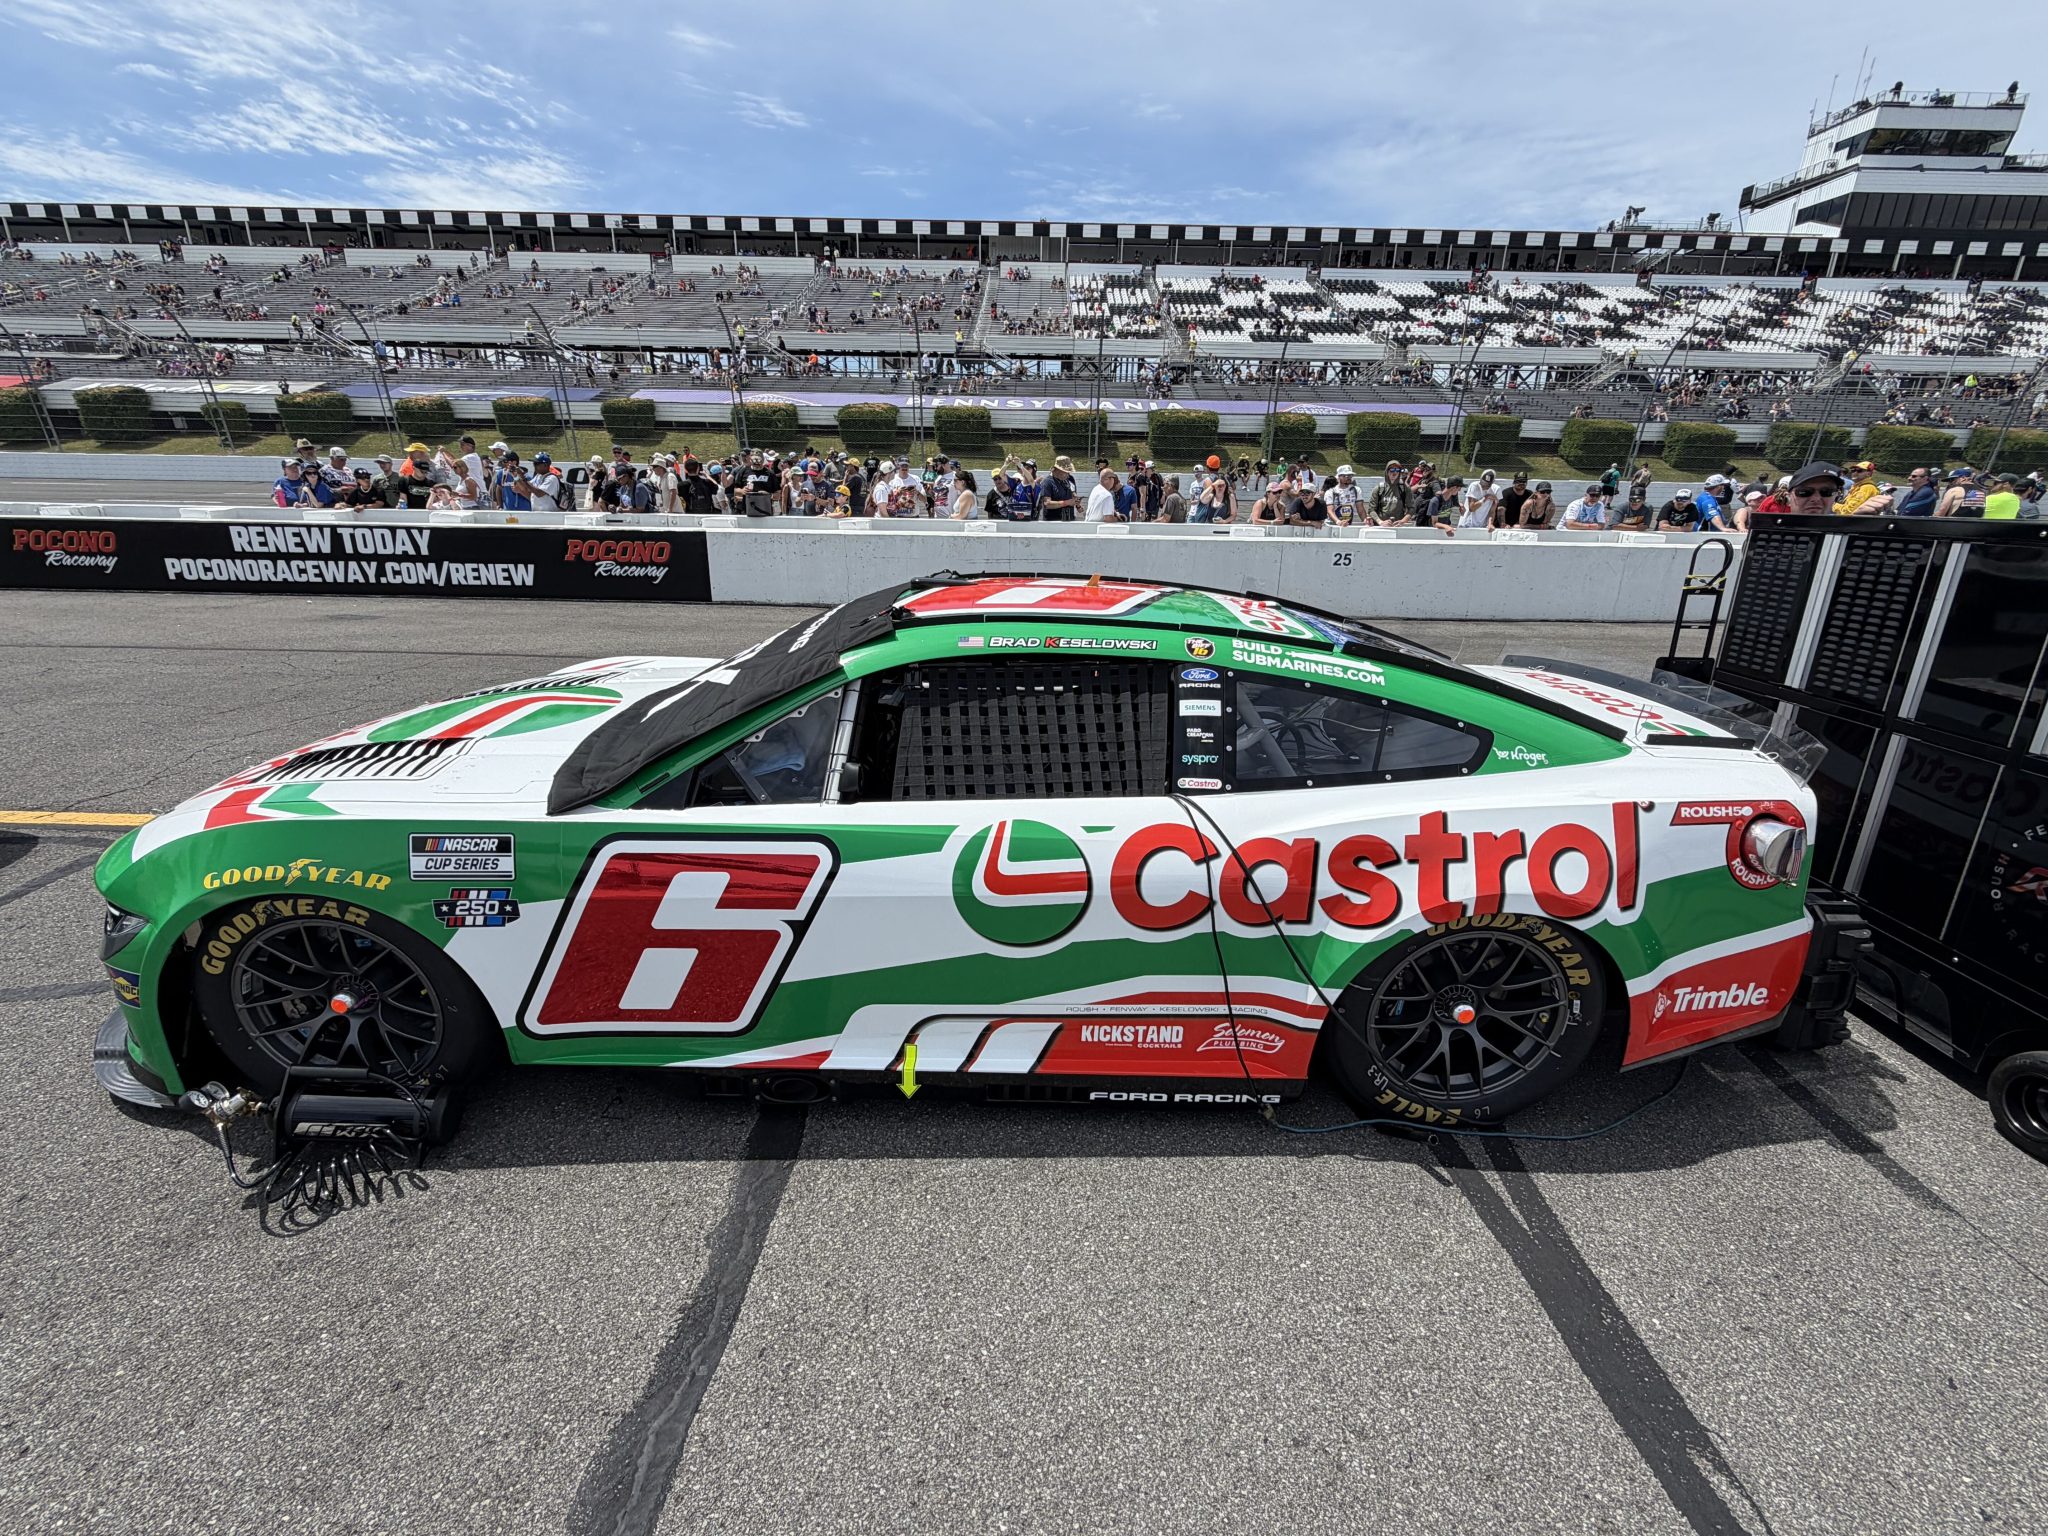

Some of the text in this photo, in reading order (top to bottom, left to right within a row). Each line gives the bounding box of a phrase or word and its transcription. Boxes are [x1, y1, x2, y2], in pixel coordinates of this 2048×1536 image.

[905, 398, 1184, 410] PENNSYLVANIA
[12, 529, 117, 552] POCONO
[229, 526, 430, 556] RENEW TODAY
[564, 539, 671, 563] POCONO
[1332, 552, 1352, 567] 25
[45, 550, 118, 574] Raceway
[165, 557, 535, 587] POCONORACEWAY.COM/RENEW
[594, 560, 670, 585] Raceway
[988, 636, 1158, 650] BRAD KESELOWSKI
[1193, 647, 1210, 656] 16
[1232, 638, 1283, 655] BUILD
[1187, 671, 1212, 680] Ford
[1232, 650, 1386, 686] SUBMARINES.COM
[1182, 755, 1219, 765] syspro
[1510, 746, 1546, 766] Kroger
[1187, 780, 1219, 788] Castrol
[440, 838, 499, 852] NASCAR
[424, 858, 500, 870] CUP SERIES
[1110, 801, 1638, 928] Castrol
[203, 866, 392, 892] GOODYEAR
[455, 900, 500, 915] 250
[202, 899, 370, 975] GOODYEAR
[524, 840, 832, 1034] 6
[1673, 983, 1768, 1013] Trimble
[1230, 1006, 1269, 1015] RACING
[1081, 1025, 1184, 1042] KICKSTAND
[1090, 1092, 1282, 1104] FORD RACING
